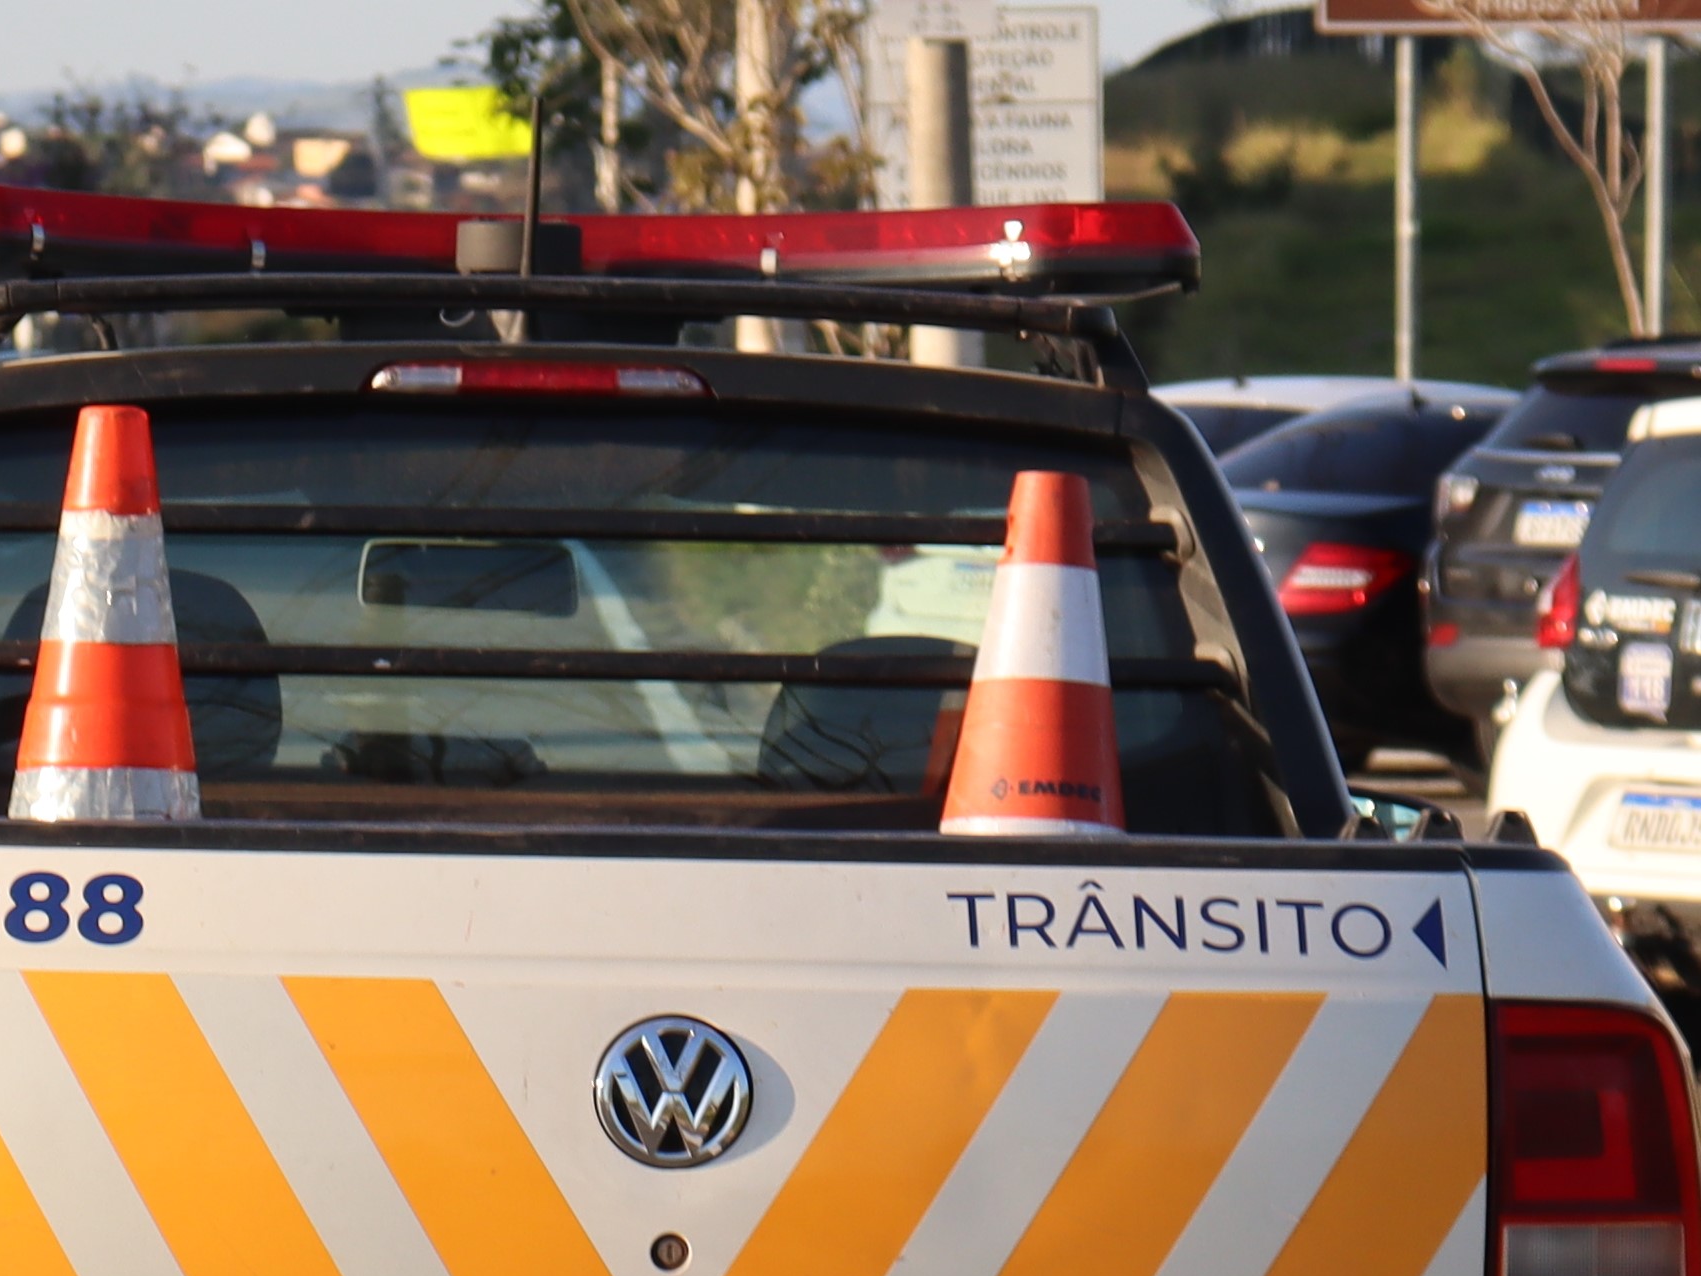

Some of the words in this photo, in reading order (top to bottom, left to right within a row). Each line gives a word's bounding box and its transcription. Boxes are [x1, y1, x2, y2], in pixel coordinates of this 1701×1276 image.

[977, 22, 1080, 42] ONTROLE
[979, 139, 1033, 154] LORA
[980, 162, 1067, 180] CÊNDIOS
[946, 880, 1393, 959] TRÂNSITO
